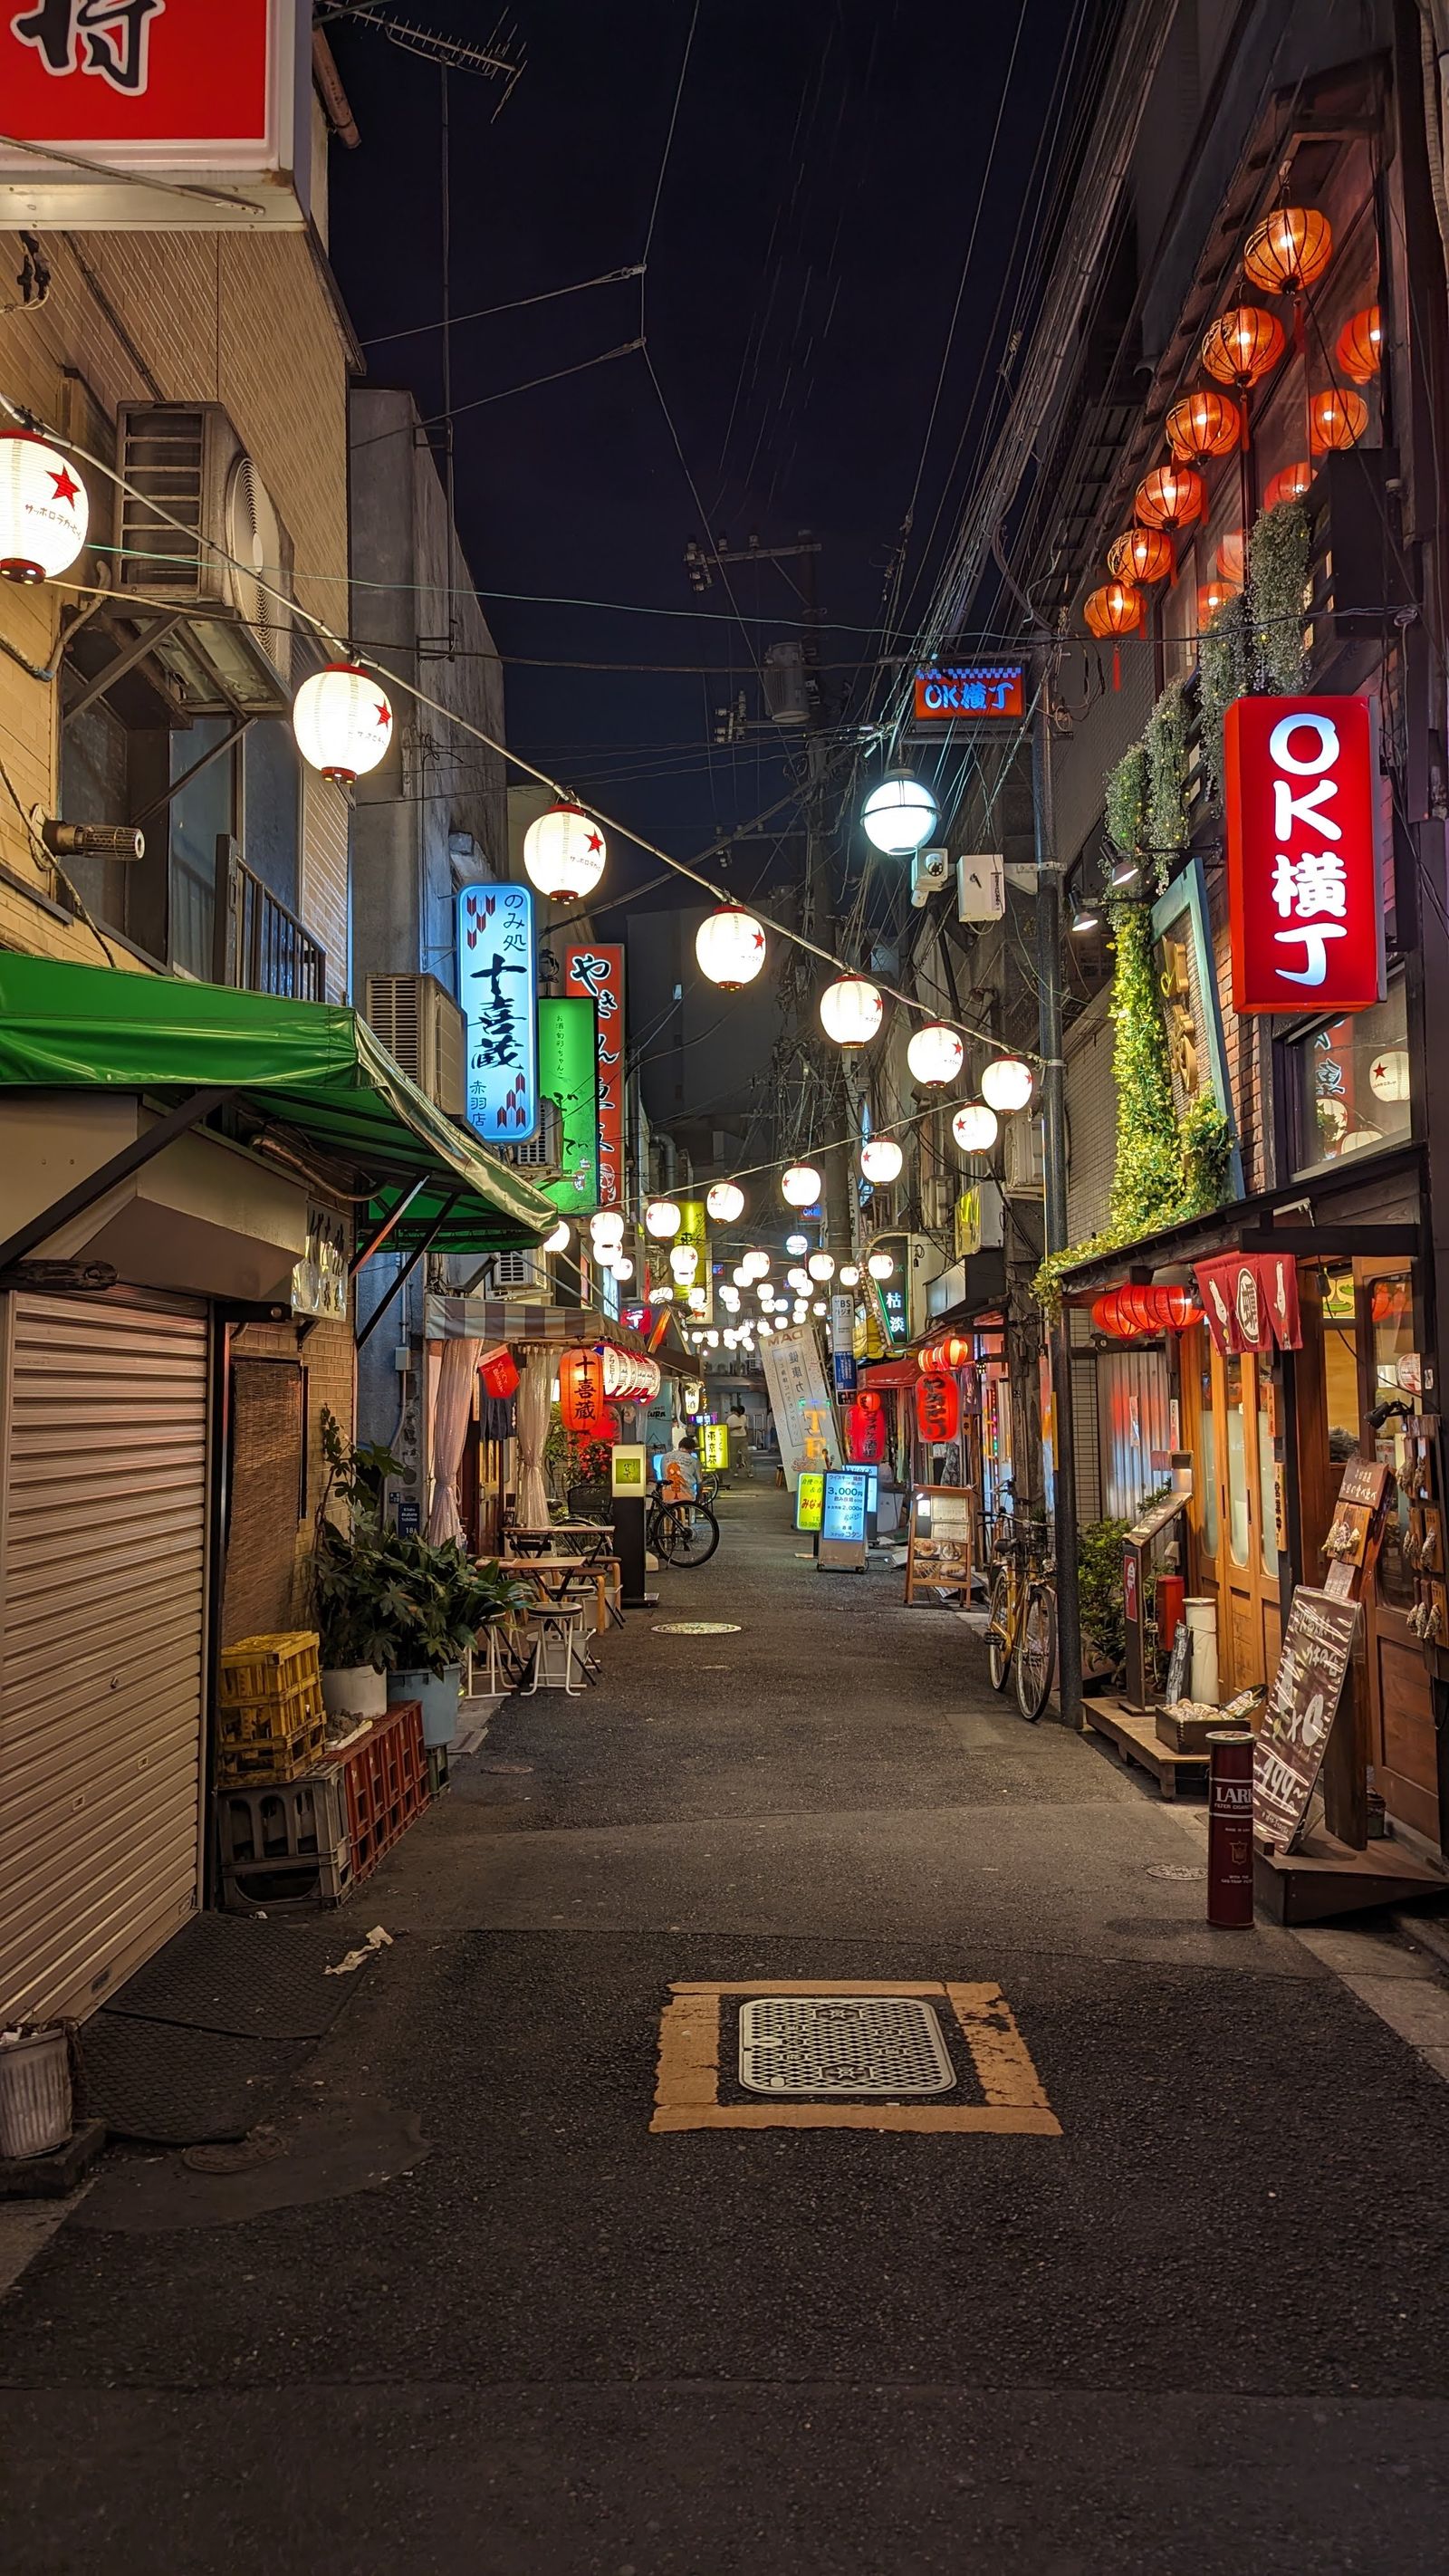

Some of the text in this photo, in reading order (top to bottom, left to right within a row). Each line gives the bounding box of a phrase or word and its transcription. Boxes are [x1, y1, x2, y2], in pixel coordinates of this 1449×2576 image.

[925, 681, 1014, 709] OK横丁
[1269, 713, 1348, 986] OK横丁
[503, 893, 526, 952] のみ処
[467, 953, 527, 1070] 十喜蔵
[469, 1080, 487, 1127] 赤羽店
[886, 1293, 905, 1332] 枯淡
[574, 1355, 596, 1420] 十喜蔵
